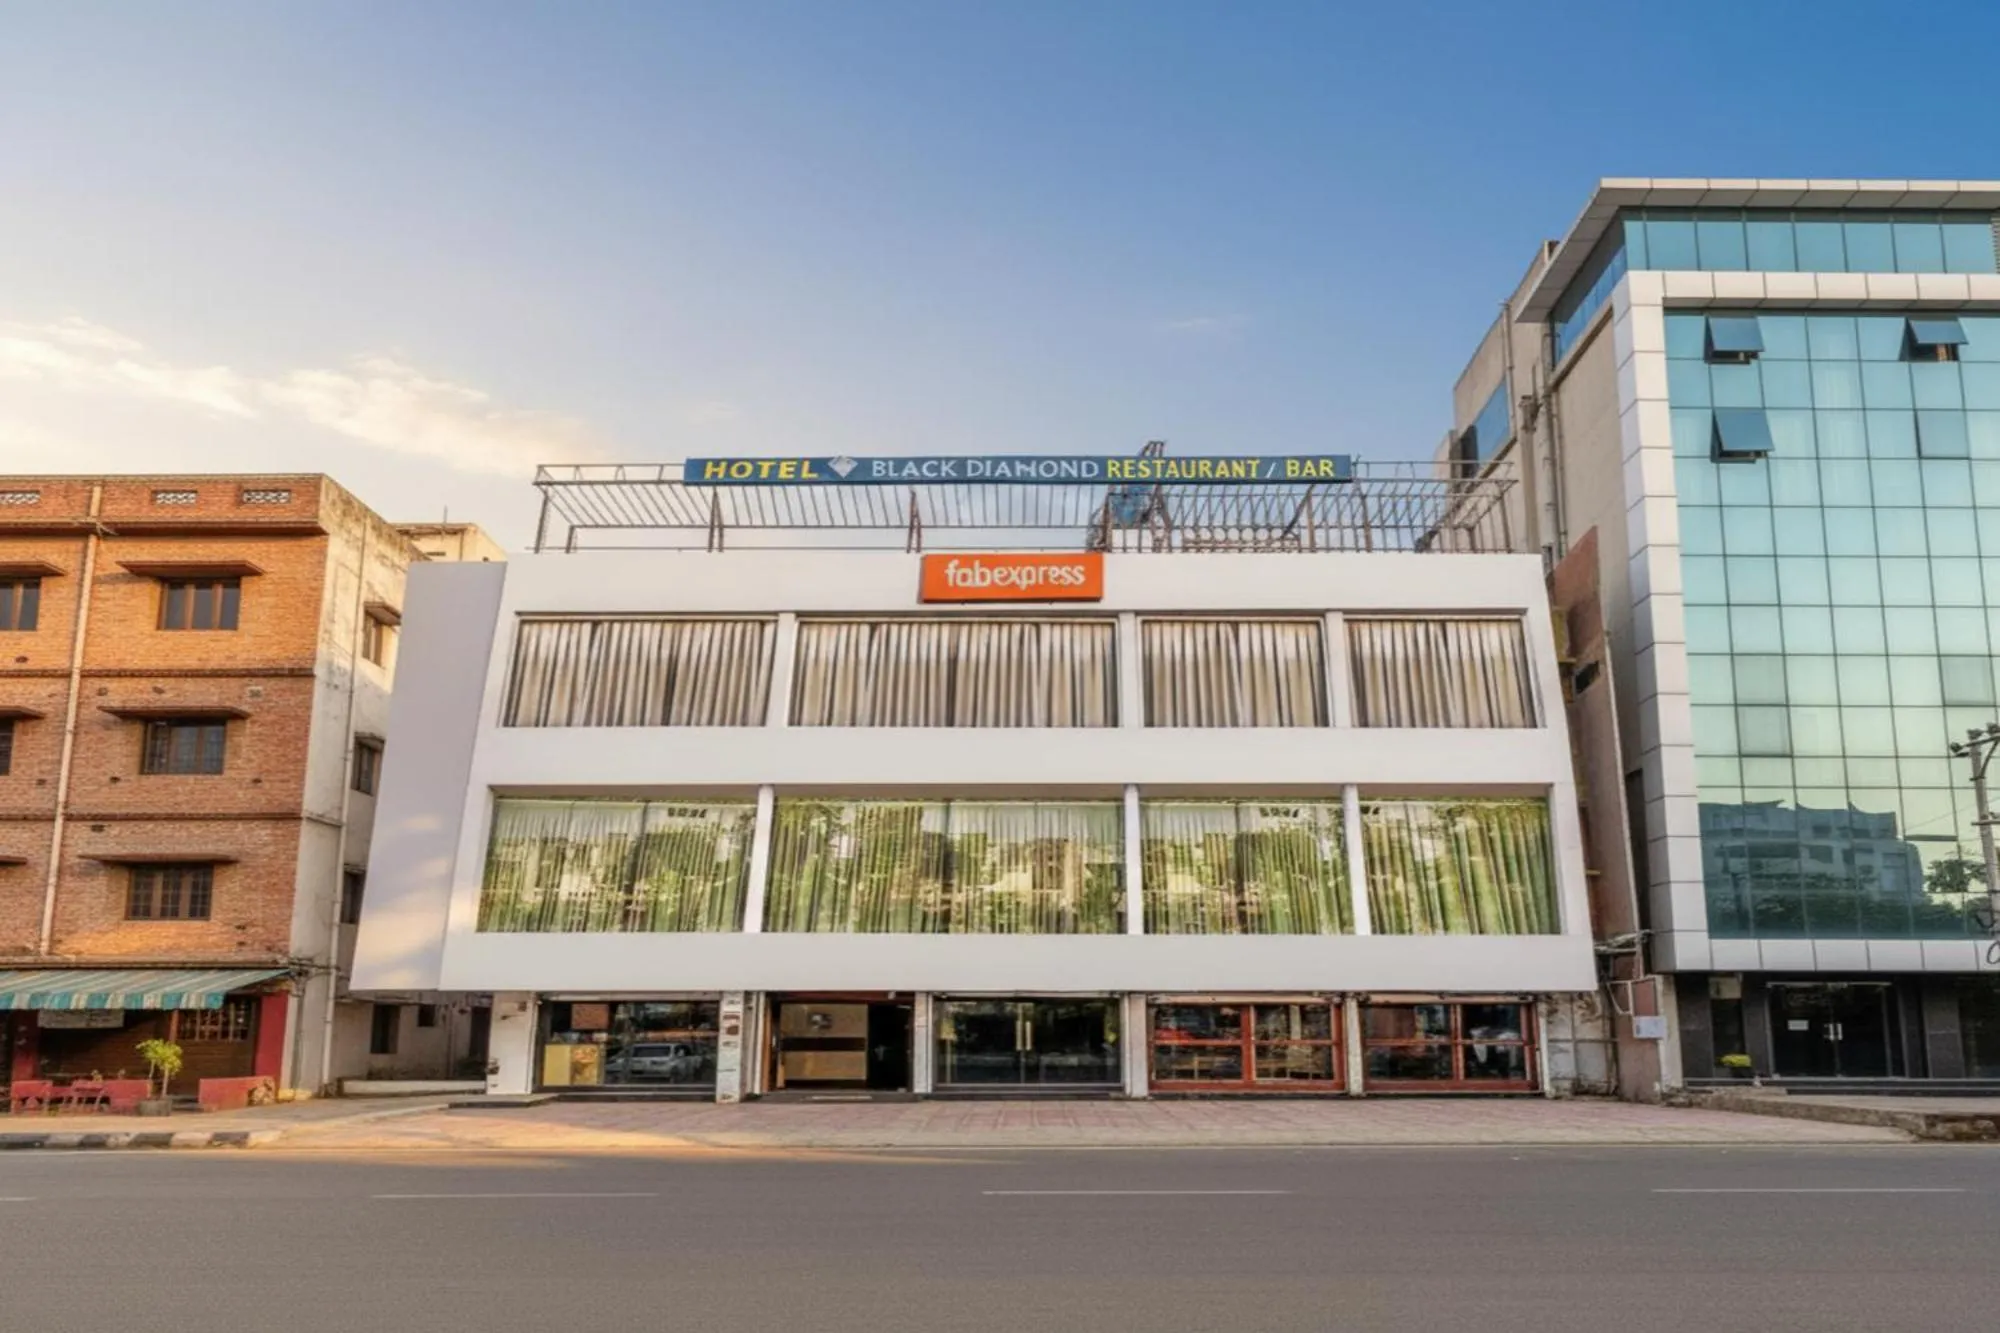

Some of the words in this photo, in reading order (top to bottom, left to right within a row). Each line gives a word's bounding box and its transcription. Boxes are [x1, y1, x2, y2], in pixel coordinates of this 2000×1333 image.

[703, 460, 819, 480] HOTEL
[871, 459, 958, 477] BLACK
[966, 459, 1099, 478] DIAMOND
[1107, 458, 1261, 479] RESTAURANT
[1285, 458, 1335, 478] BAR
[944, 558, 1086, 591] fabexpress
